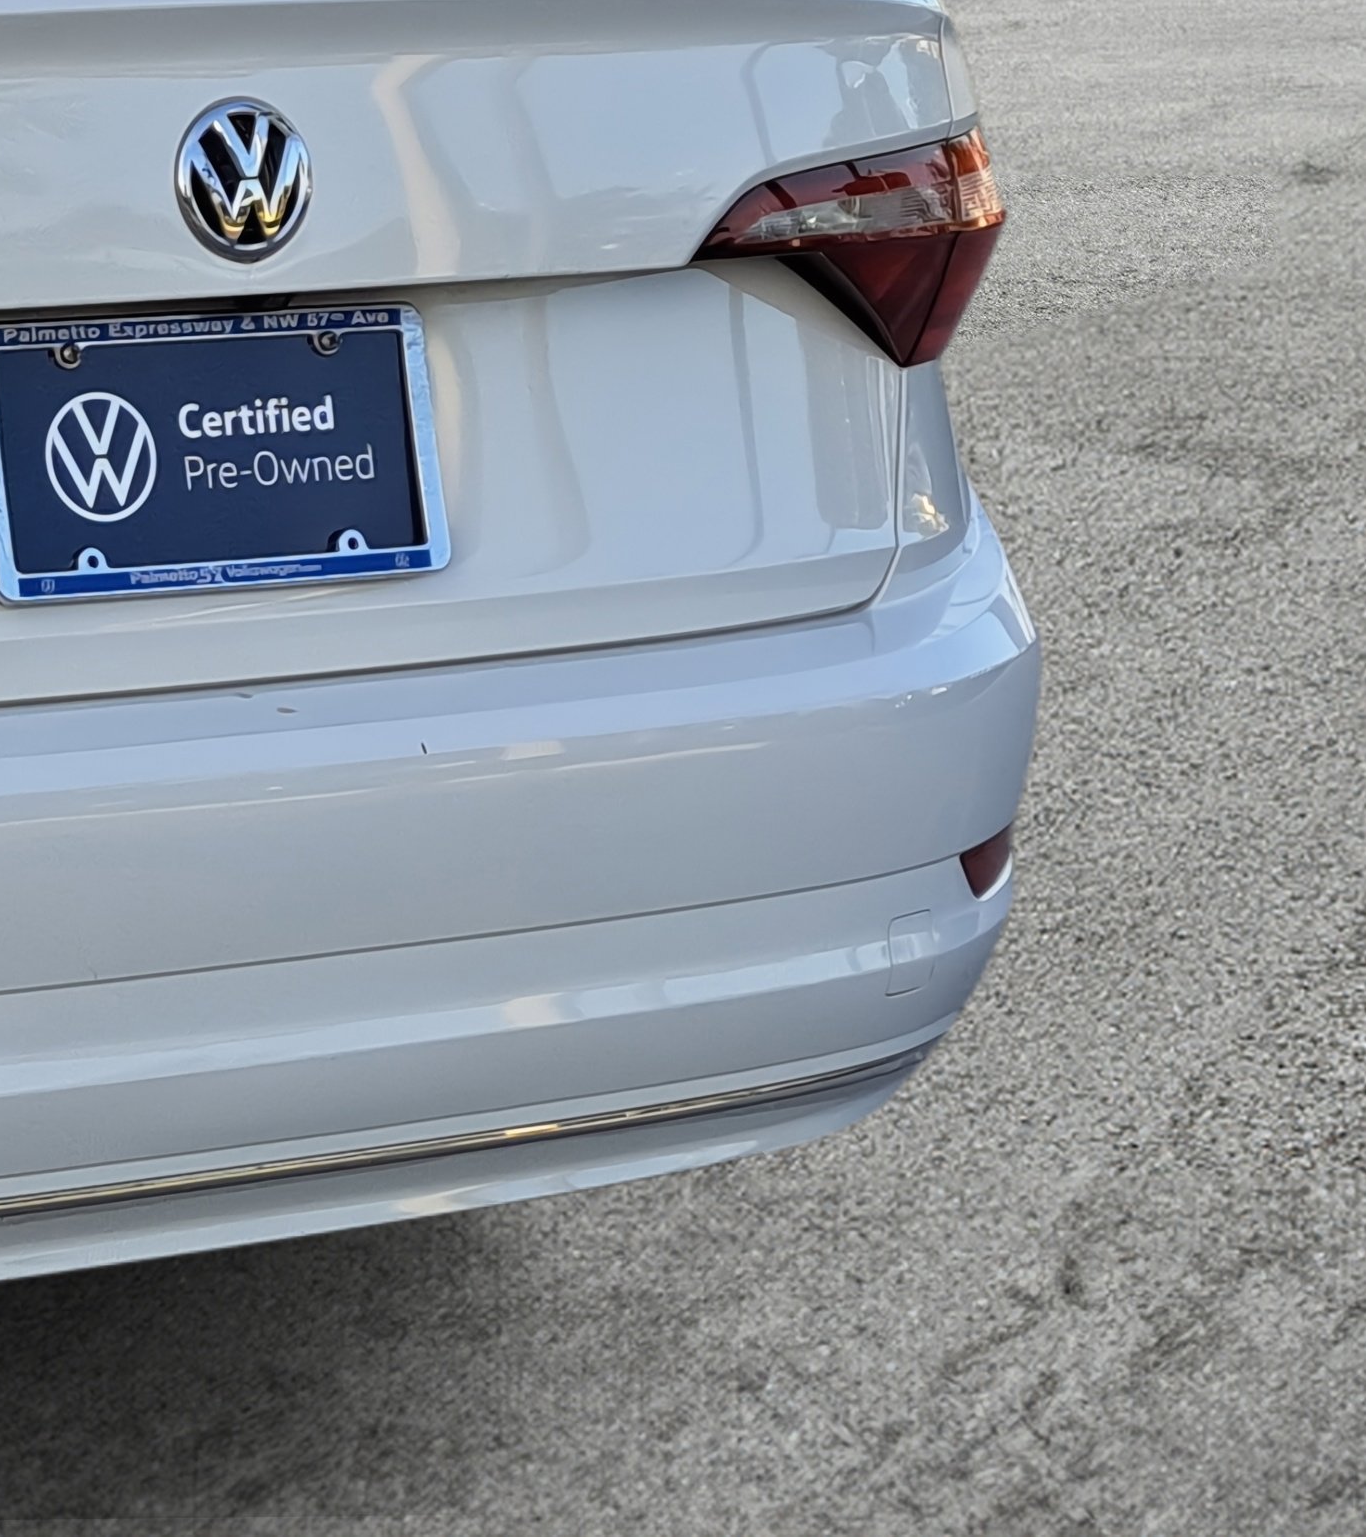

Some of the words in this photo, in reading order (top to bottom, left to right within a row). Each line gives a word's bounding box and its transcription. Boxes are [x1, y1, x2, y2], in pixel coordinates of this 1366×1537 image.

[177, 101, 307, 258] VW
[3, 324, 101, 344] Palmetto
[108, 318, 234, 339] Expressway
[263, 313, 300, 329] NW
[351, 310, 389, 325] Ave
[178, 394, 335, 439] Certified
[46, 393, 155, 519] VW
[184, 443, 375, 491] Pre-Owned
